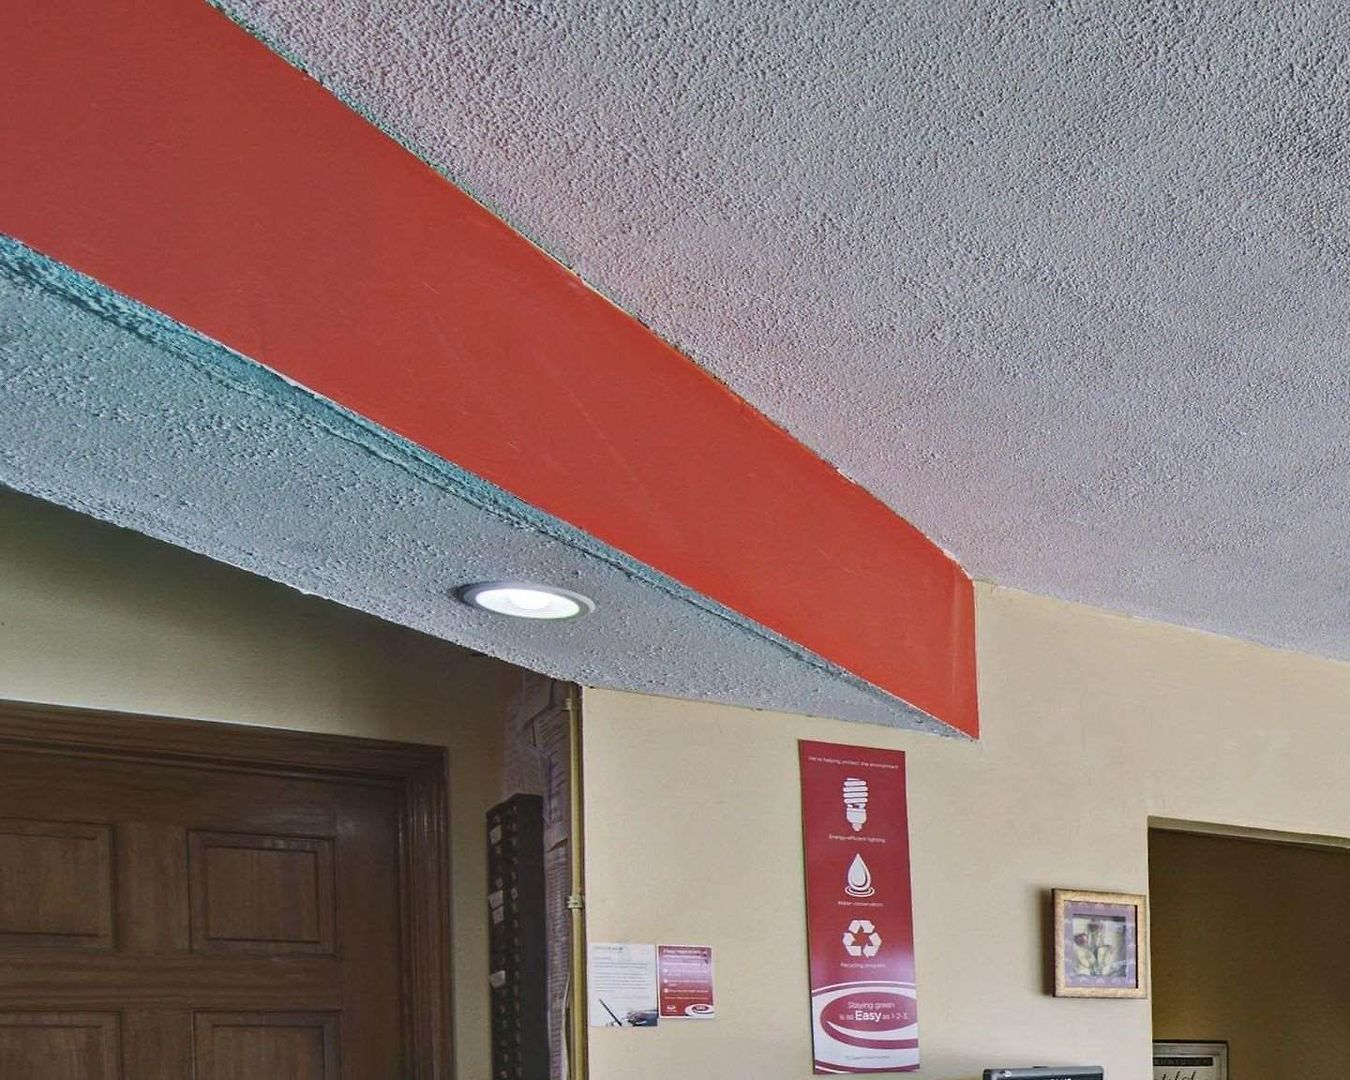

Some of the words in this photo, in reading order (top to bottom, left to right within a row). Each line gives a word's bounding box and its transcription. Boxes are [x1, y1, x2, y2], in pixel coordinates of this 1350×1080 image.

[848, 1001, 874, 1009] Staying
[875, 1001, 895, 1010] green
[855, 1010, 882, 1022] Easy
